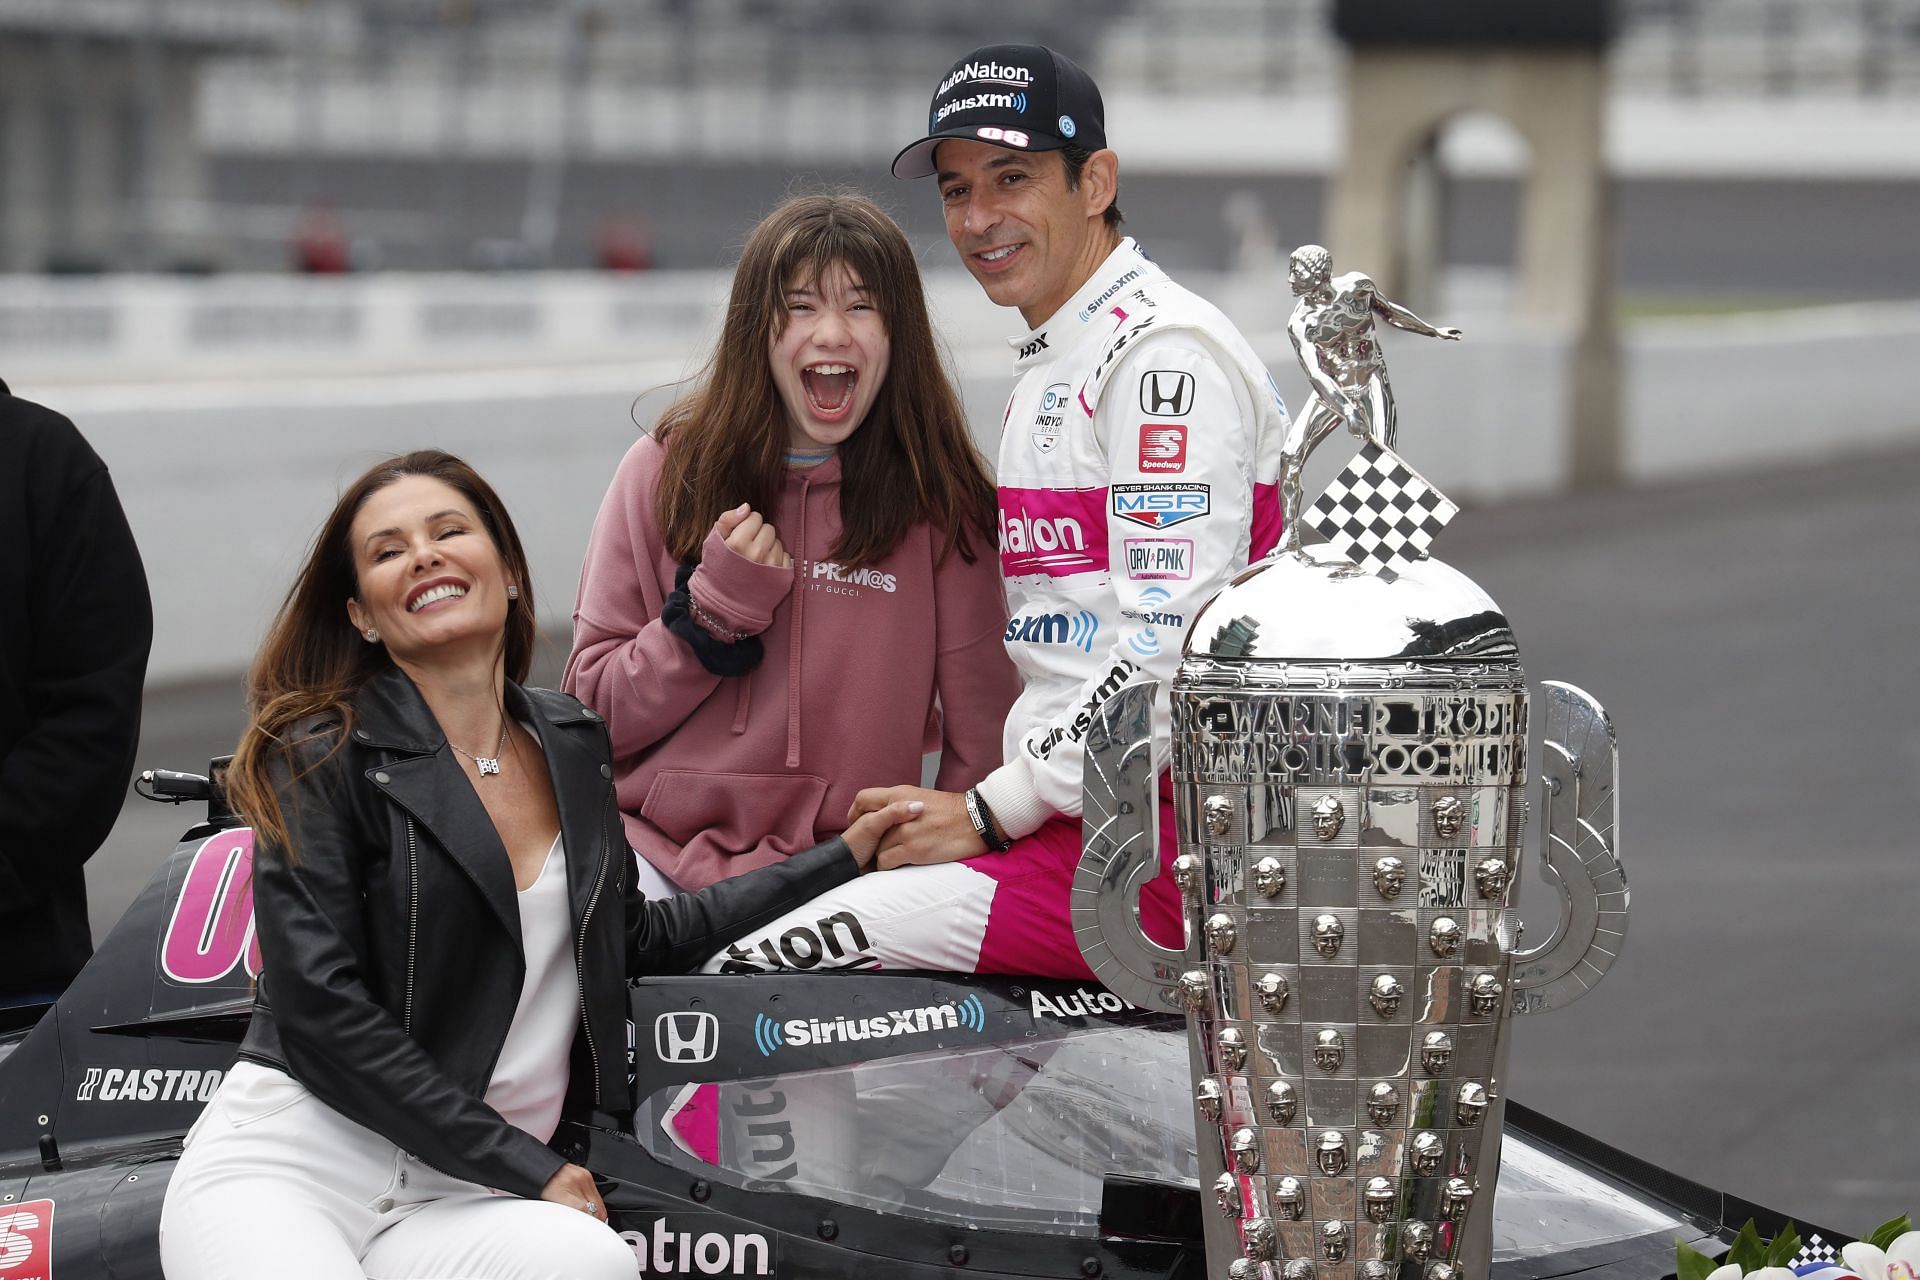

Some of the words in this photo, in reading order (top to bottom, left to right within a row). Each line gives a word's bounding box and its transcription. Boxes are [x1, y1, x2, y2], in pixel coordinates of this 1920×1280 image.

[936, 61, 1030, 100] AutoNation
[976, 127, 1030, 148] 06
[1142, 460, 1182, 470] Speedway
[1113, 484, 1141, 492] MEYER
[1143, 484, 1173, 492] SHANK
[1175, 484, 1209, 492] RACING
[1117, 494, 1206, 510] MSR
[1130, 548, 1150, 570] DRV
[1156, 548, 1184, 571] PNK
[811, 583, 821, 591] IT
[161, 827, 263, 983] 0
[99, 1068, 229, 1101] CASTRO
